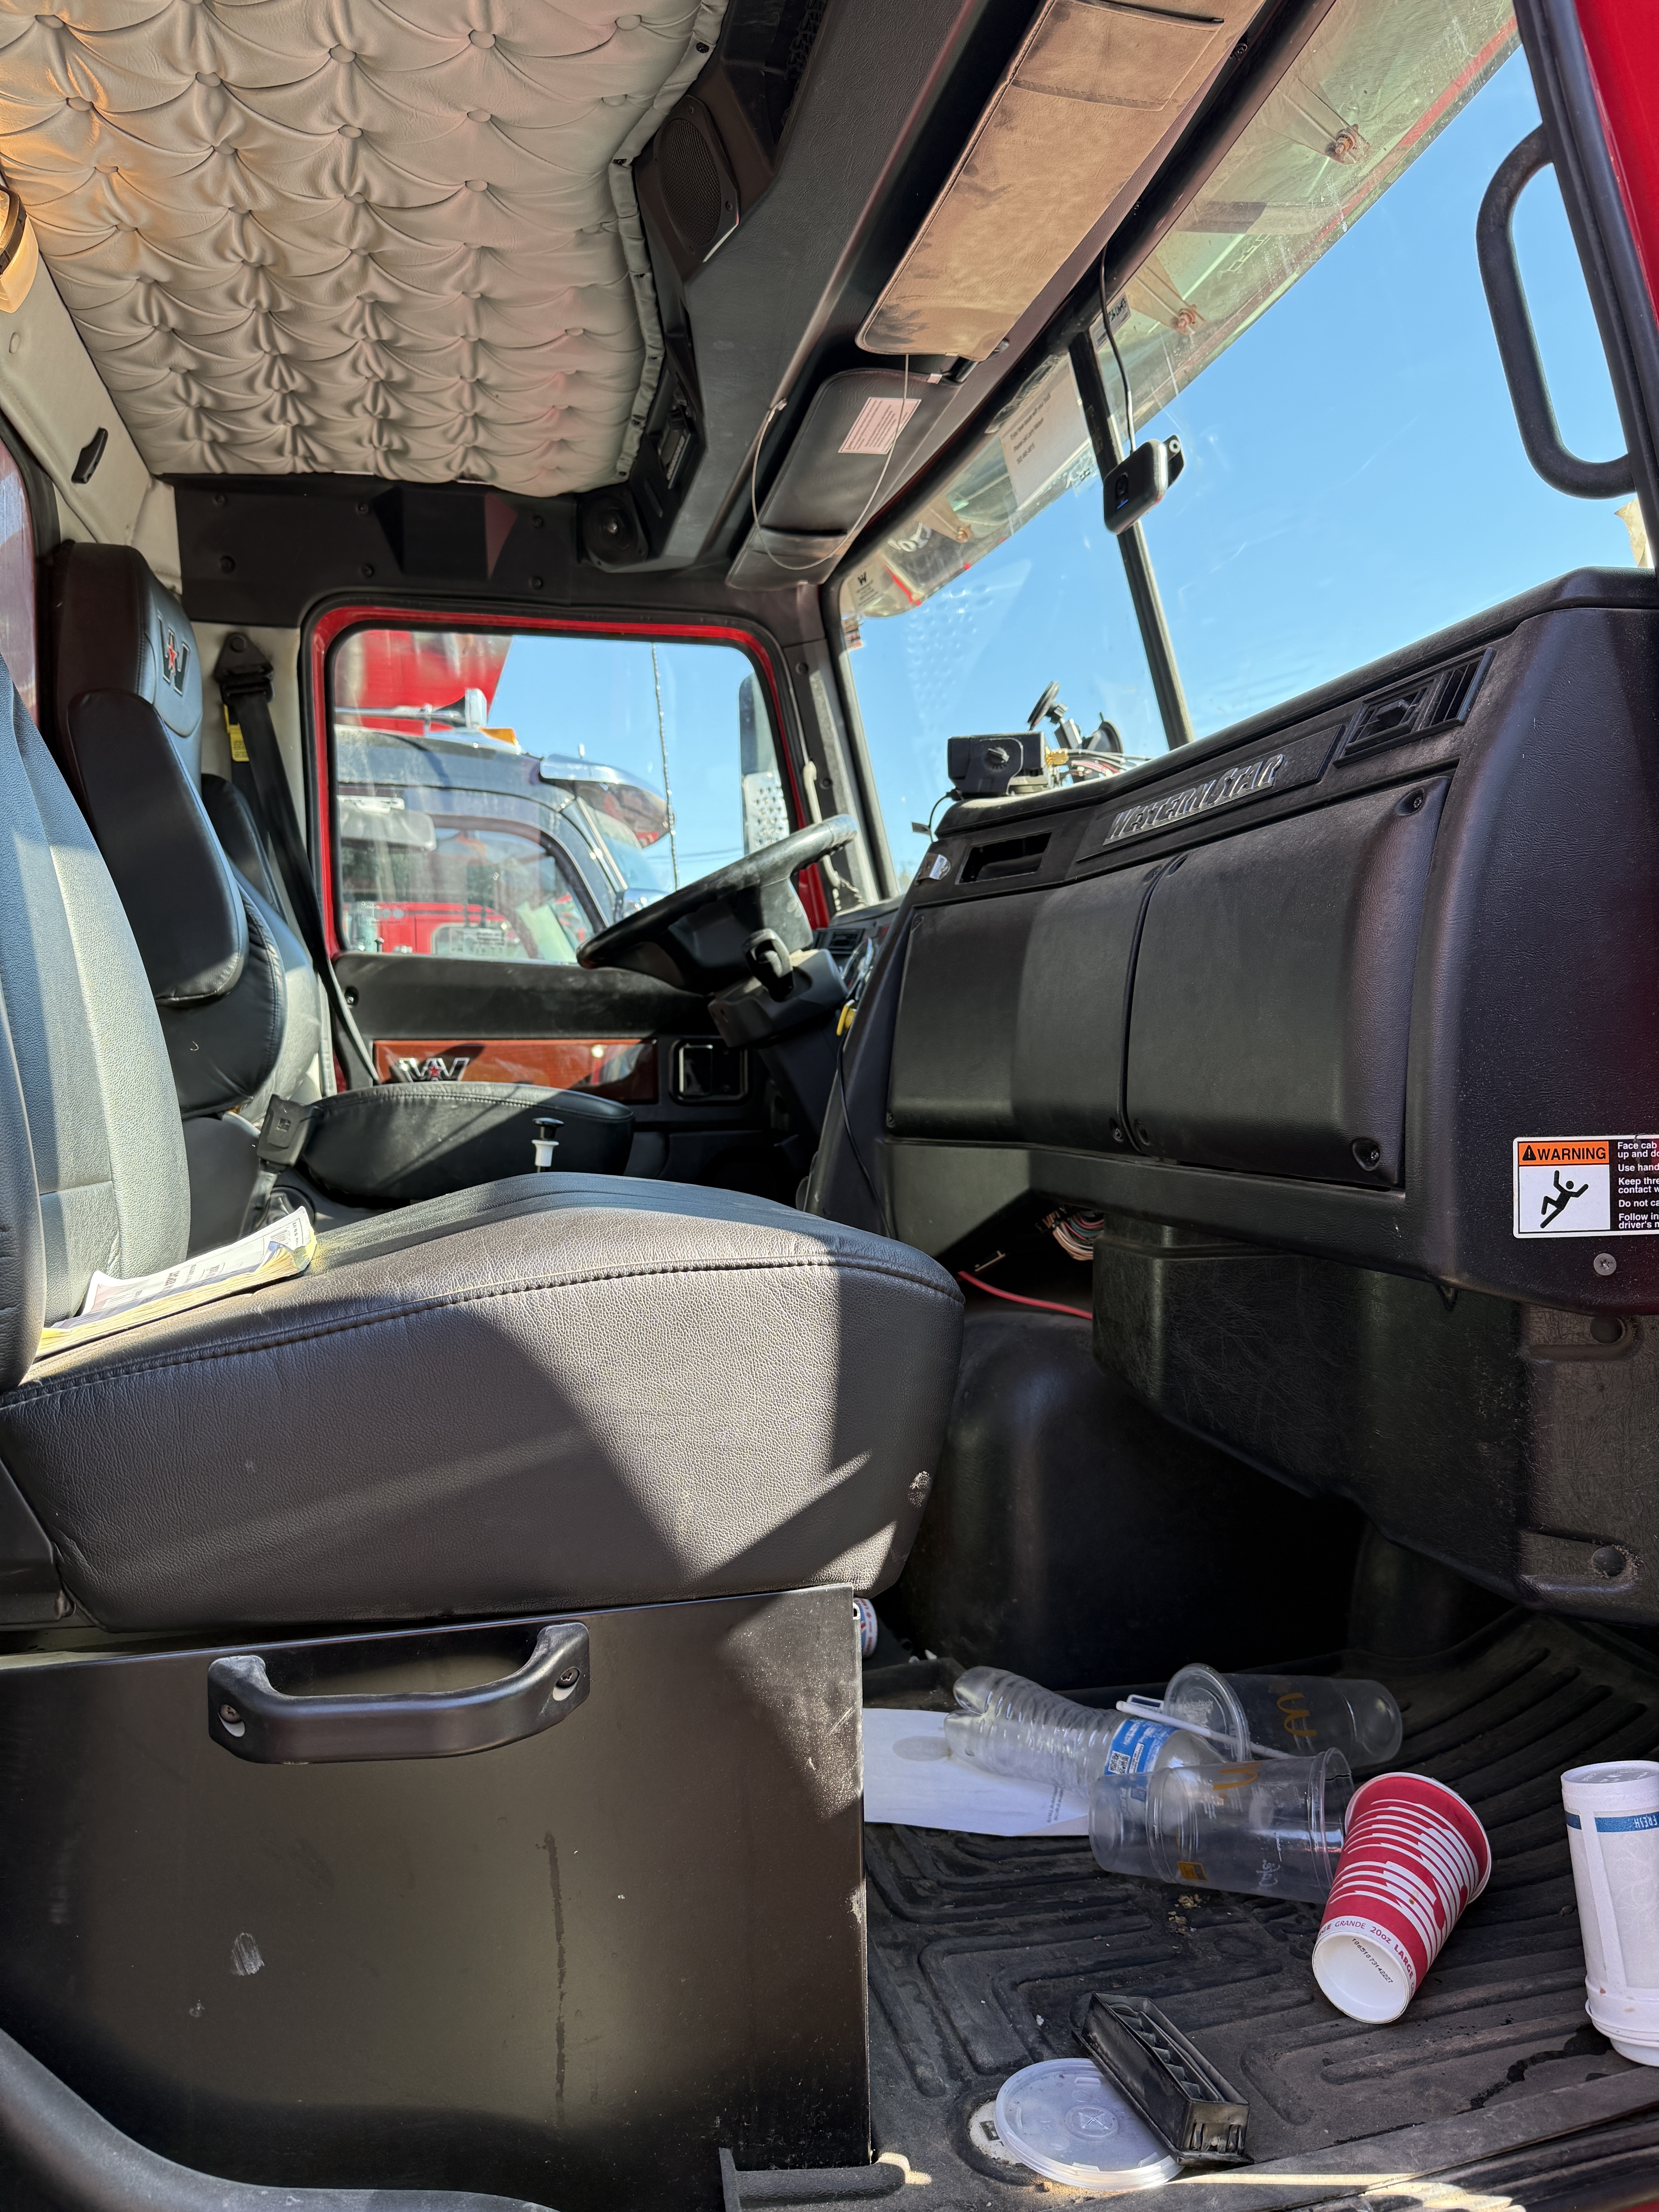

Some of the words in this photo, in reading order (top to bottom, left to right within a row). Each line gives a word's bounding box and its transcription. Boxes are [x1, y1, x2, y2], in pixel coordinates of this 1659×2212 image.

[1108, 779, 1218, 840] WESTERN
[1209, 754, 1285, 804] STAR
[1537, 1147, 1606, 1161] WARNING
[1618, 1151, 1629, 1159] up
[1618, 1177, 1641, 1188] Keep
[1618, 1185, 1652, 1194] contact
[1618, 1199, 1631, 1207] Do
[1619, 1213, 1648, 1221] Follow
[1618, 1221, 1652, 1229] driver's
[1634, 1815, 1657, 1828] FRESH
[1335, 1920, 1366, 1929] GRANDE
[1394, 1944, 1413, 1980] LARGE
